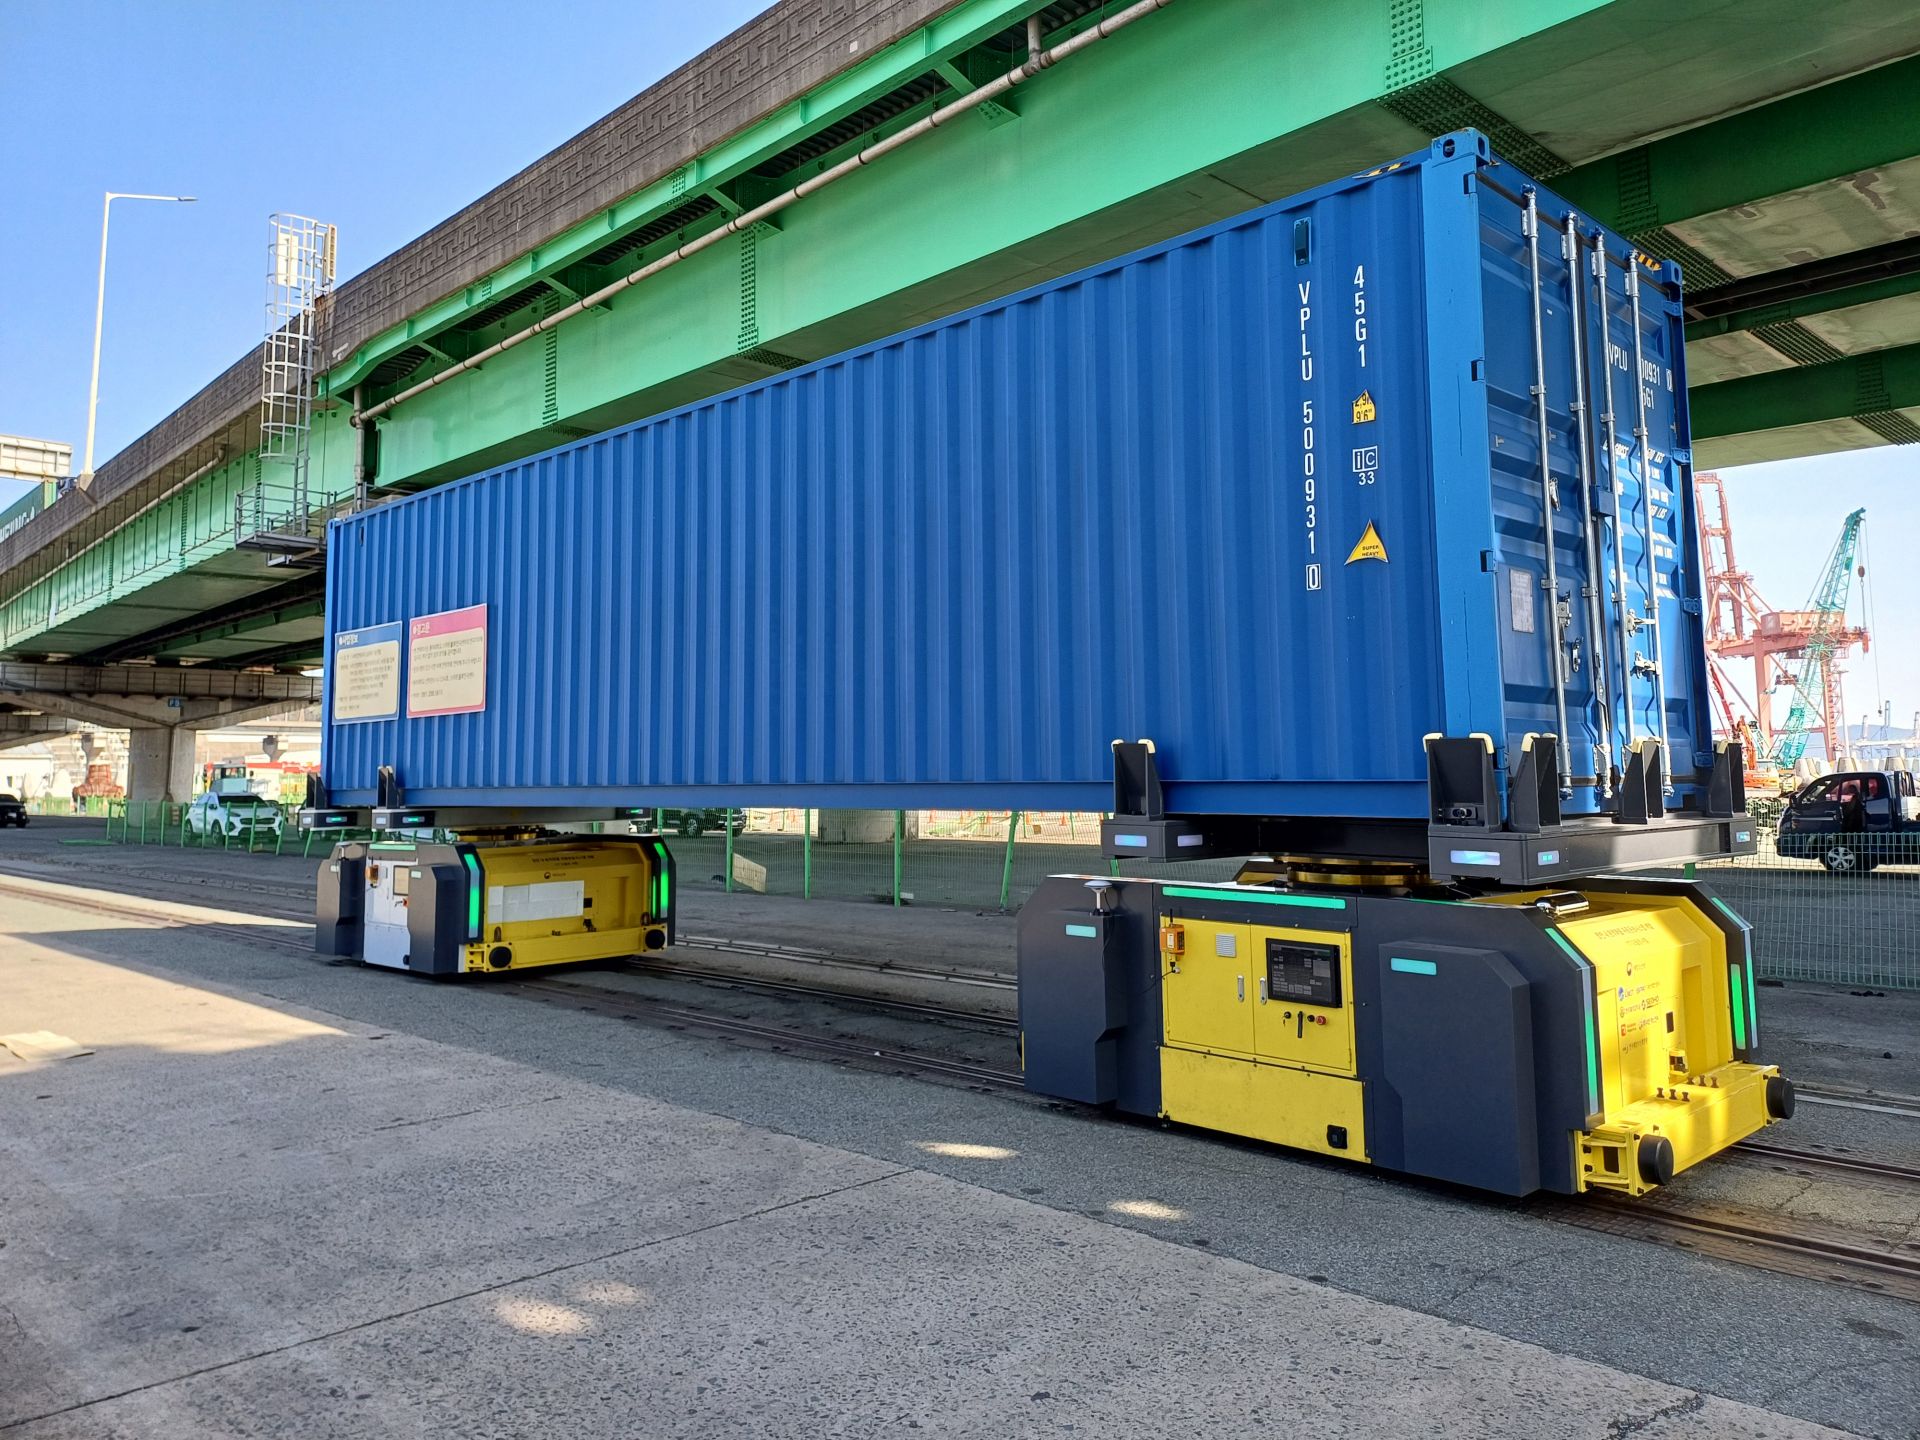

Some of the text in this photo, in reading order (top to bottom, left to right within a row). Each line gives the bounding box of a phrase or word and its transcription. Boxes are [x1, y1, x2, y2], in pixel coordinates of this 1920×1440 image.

[1298, 281, 1313, 381] VPLU
[1354, 265, 1367, 367] 45G1
[1303, 400, 1316, 554] 500931
[1358, 472, 1375, 485] 33
